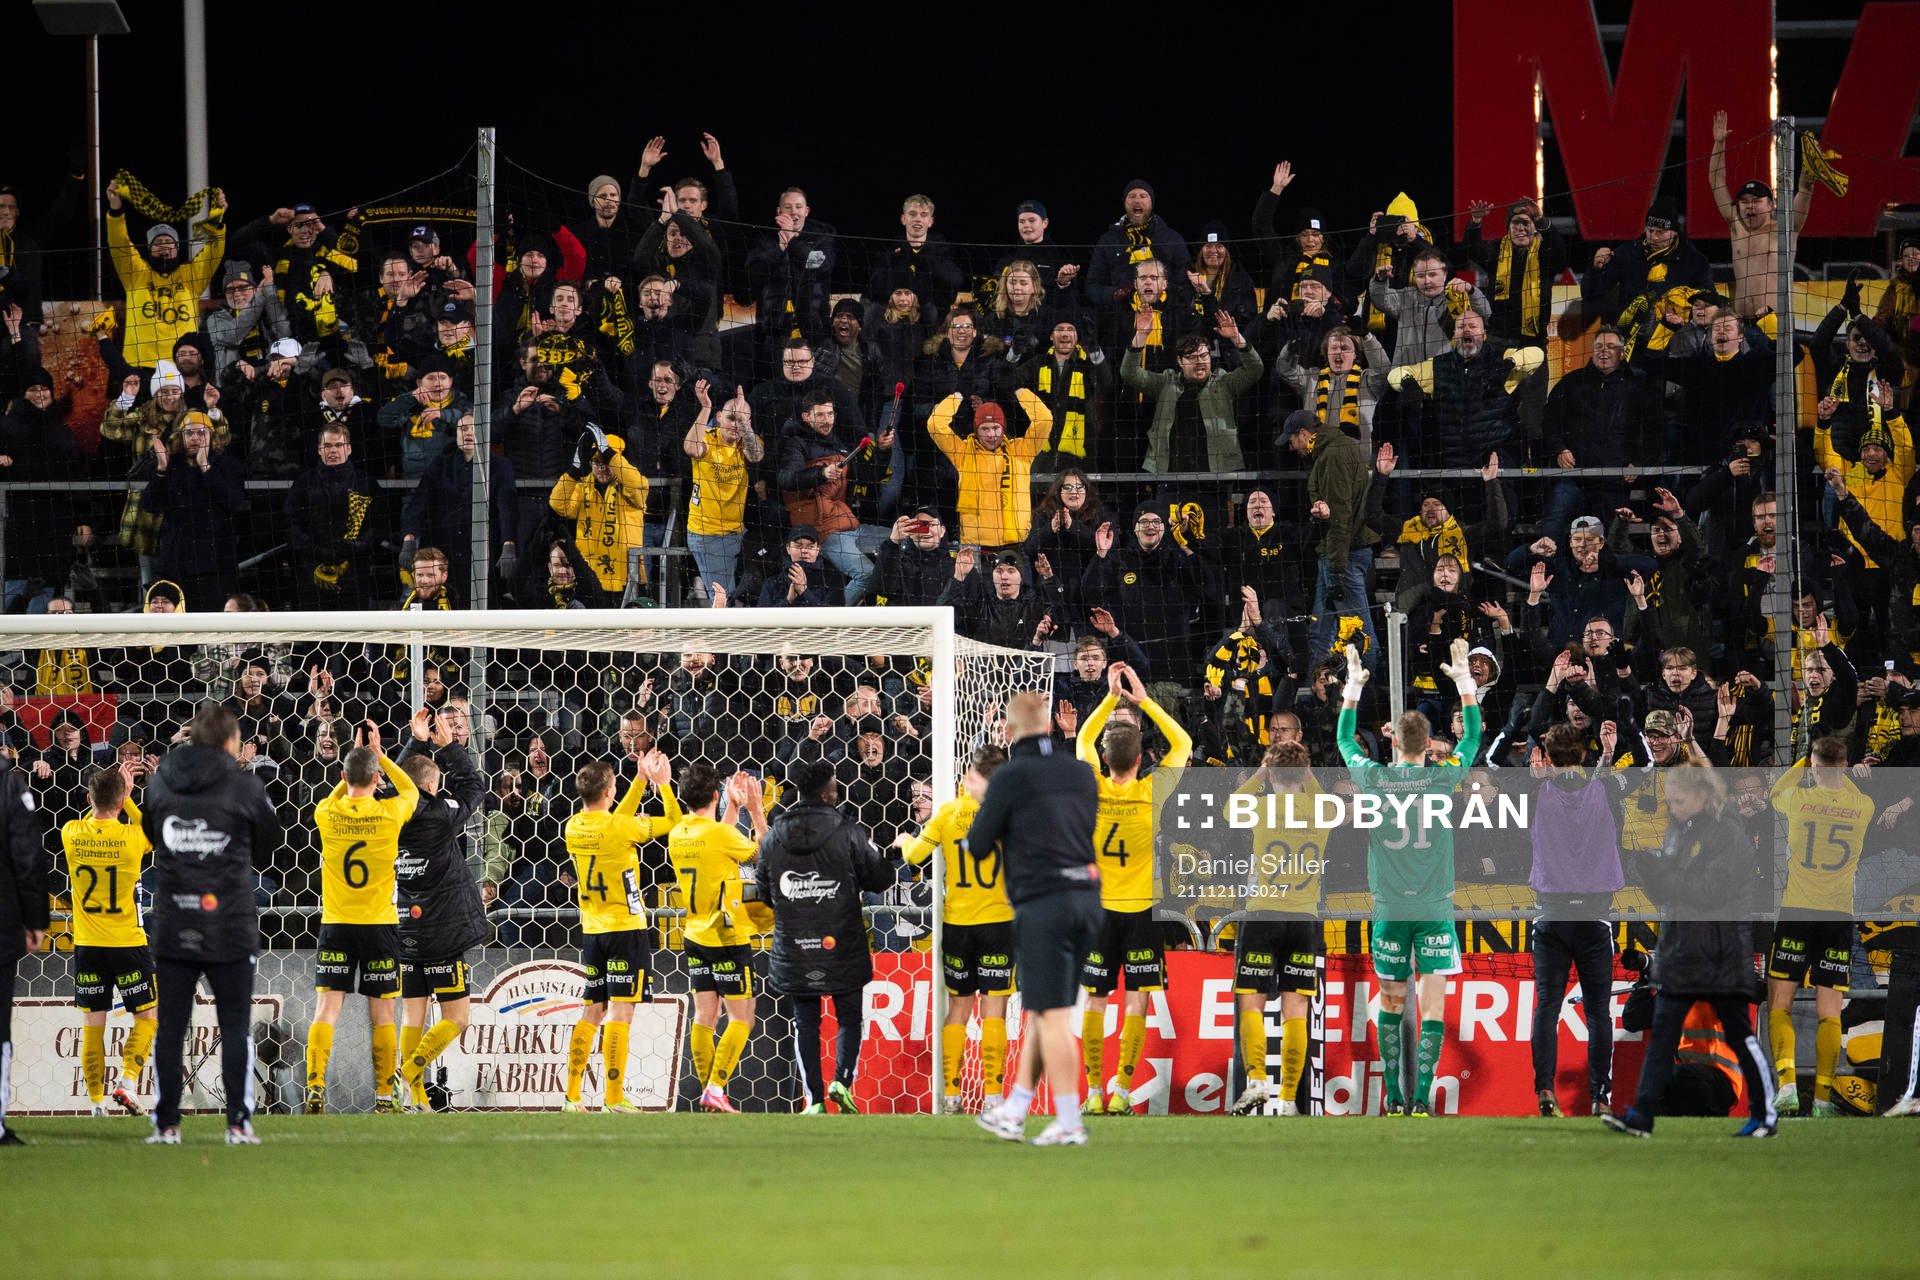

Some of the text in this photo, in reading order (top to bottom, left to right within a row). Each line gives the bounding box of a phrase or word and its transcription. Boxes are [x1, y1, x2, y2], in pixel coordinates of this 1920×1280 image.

[328, 812, 382, 824] Sparbanken
[1800, 803, 1861, 819] PULSEN
[333, 824, 377, 837] Sjuhärad
[1382, 798, 1432, 850] 31
[71, 837, 126, 849] Sparbanken
[1102, 822, 1130, 867] 4
[1800, 821, 1853, 871] 15
[343, 840, 369, 889] 6
[953, 838, 1001, 889] 10
[1265, 841, 1320, 891] 29
[75, 865, 122, 914] 21
[680, 868, 697, 914] 7
[1427, 935, 1451, 947] EAB
[320, 951, 345, 962] EAB
[982, 955, 1005, 966] EAB
[1129, 950, 1151, 962] EAB
[1248, 953, 1272, 965] EAB
[1291, 953, 1314, 965] EAB
[423, 964, 453, 975] ernera
[120, 982, 149, 996] ernera
[475, 1062, 602, 1094] FABRIKN
